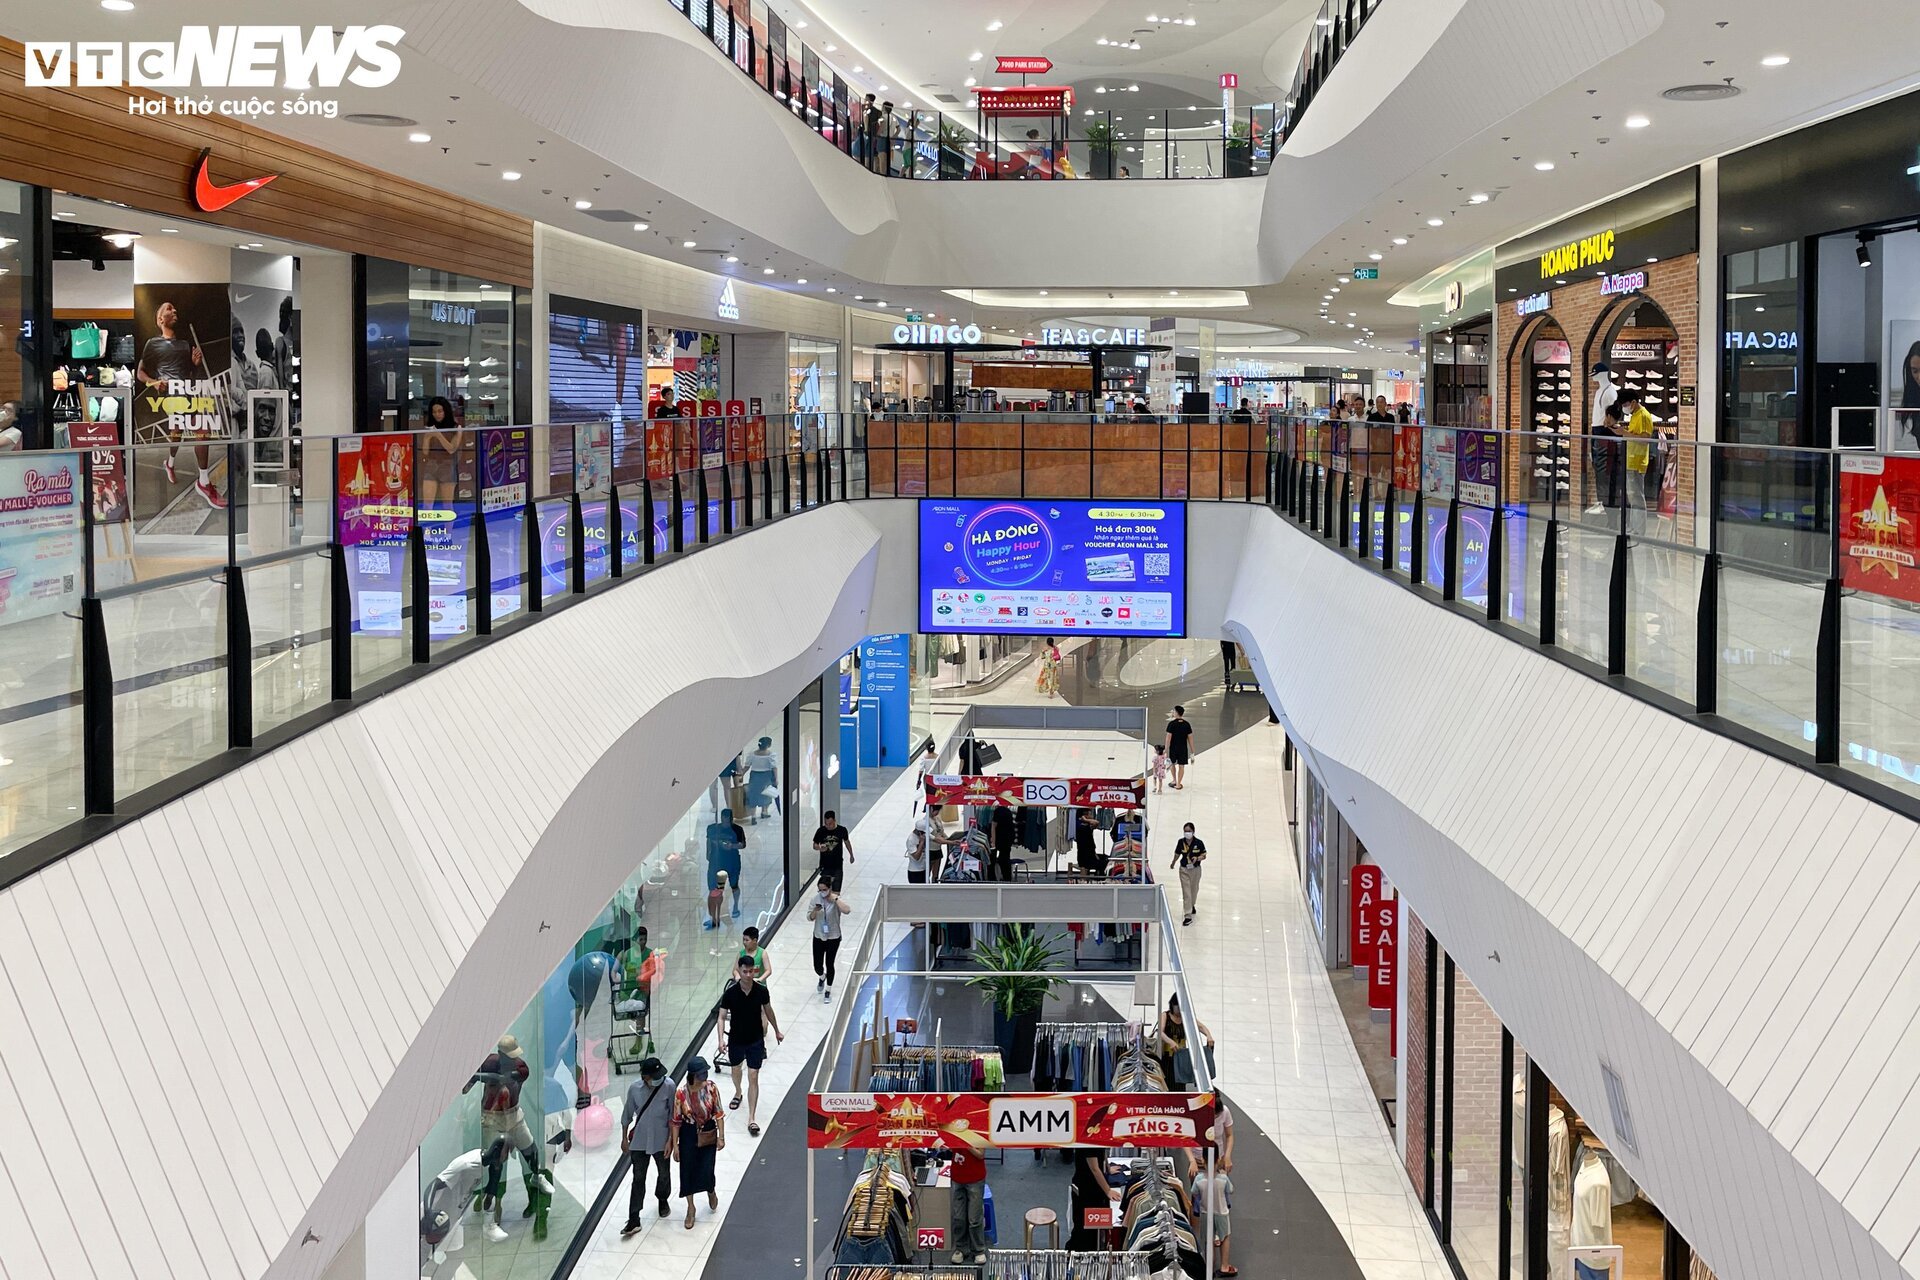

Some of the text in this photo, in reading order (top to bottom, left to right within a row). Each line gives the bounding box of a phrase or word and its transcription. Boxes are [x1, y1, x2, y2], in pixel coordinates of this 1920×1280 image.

[1002, 61, 1047, 69] FOOD PARK STATION
[1541, 230, 1615, 279] HOANG PHUC
[1611, 272, 1644, 294] Kappa
[431, 302, 476, 326] JUST DO IT
[718, 304, 739, 320] adidas
[1042, 328, 1145, 345] TEA&CAFE
[168, 380, 221, 395] RUN
[146, 397, 214, 412] YOUR
[168, 415, 221, 430] RUN
[731, 405, 741, 453] SALE
[25, 466, 72, 493] Ra mắt
[5, 499, 27, 509] MALL
[28, 493, 73, 507] E-VOUCHER
[971, 523, 1039, 545] HÀ ĐÔNG
[1095, 525, 1157, 533] Hoá đơn 300k
[977, 541, 1041, 558] Happy Hour
[1013, 554, 1032, 562] FRIDAY
[1026, 784, 1067, 801] BOO
[1359, 873, 1374, 944] SALE
[1377, 909, 1393, 985] SALE
[849, 1098, 871, 1106] MALL
[1126, 1104, 1186, 1115] VỊ TRÍ CỬA HÀNG
[996, 1110, 1070, 1132] AMM
[1174, 1122, 1183, 1133] 2
[1087, 1213, 1100, 1223] 99
[920, 1233, 944, 1247] 20%
